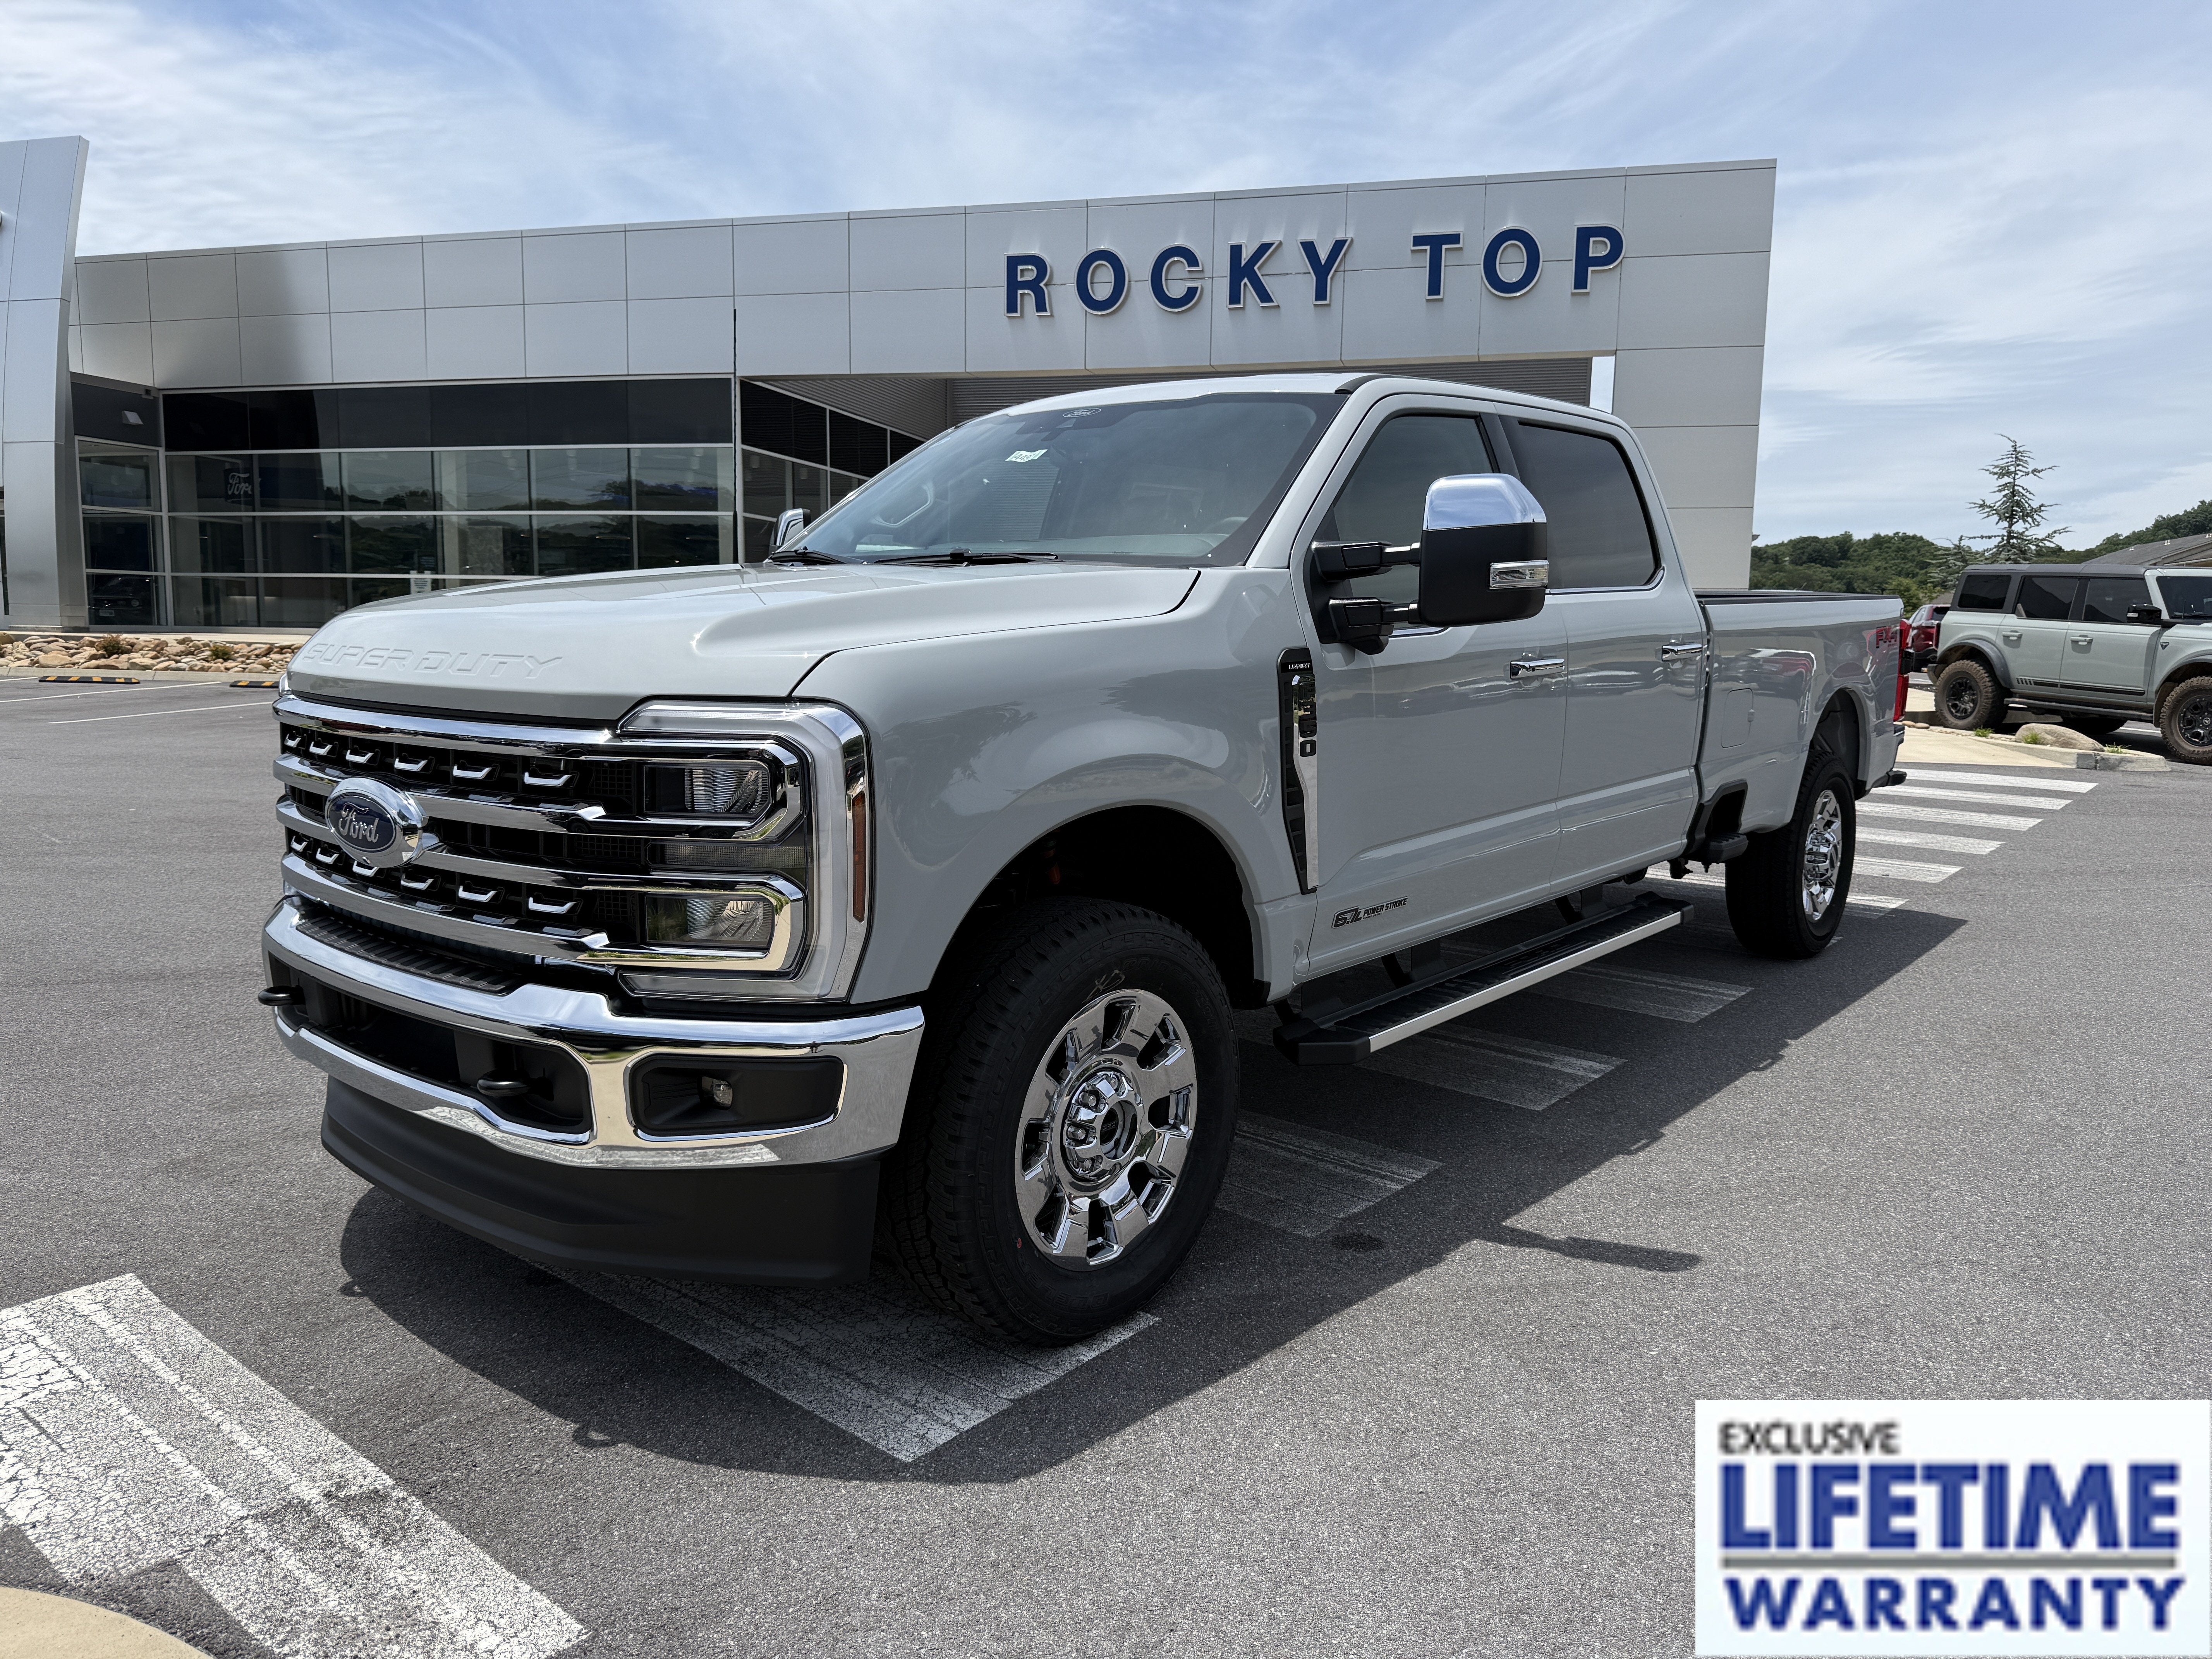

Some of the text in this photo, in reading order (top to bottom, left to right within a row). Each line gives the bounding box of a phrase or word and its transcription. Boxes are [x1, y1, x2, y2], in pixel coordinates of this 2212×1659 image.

[1004, 223, 1626, 316] ROCKY TOP
[303, 643, 562, 679] SUPER DUTY
[338, 802, 379, 843] Ford
[1334, 907, 1362, 927] 6.7L
[1363, 905, 1384, 917] POWER
[1384, 897, 1408, 911] STROKE
